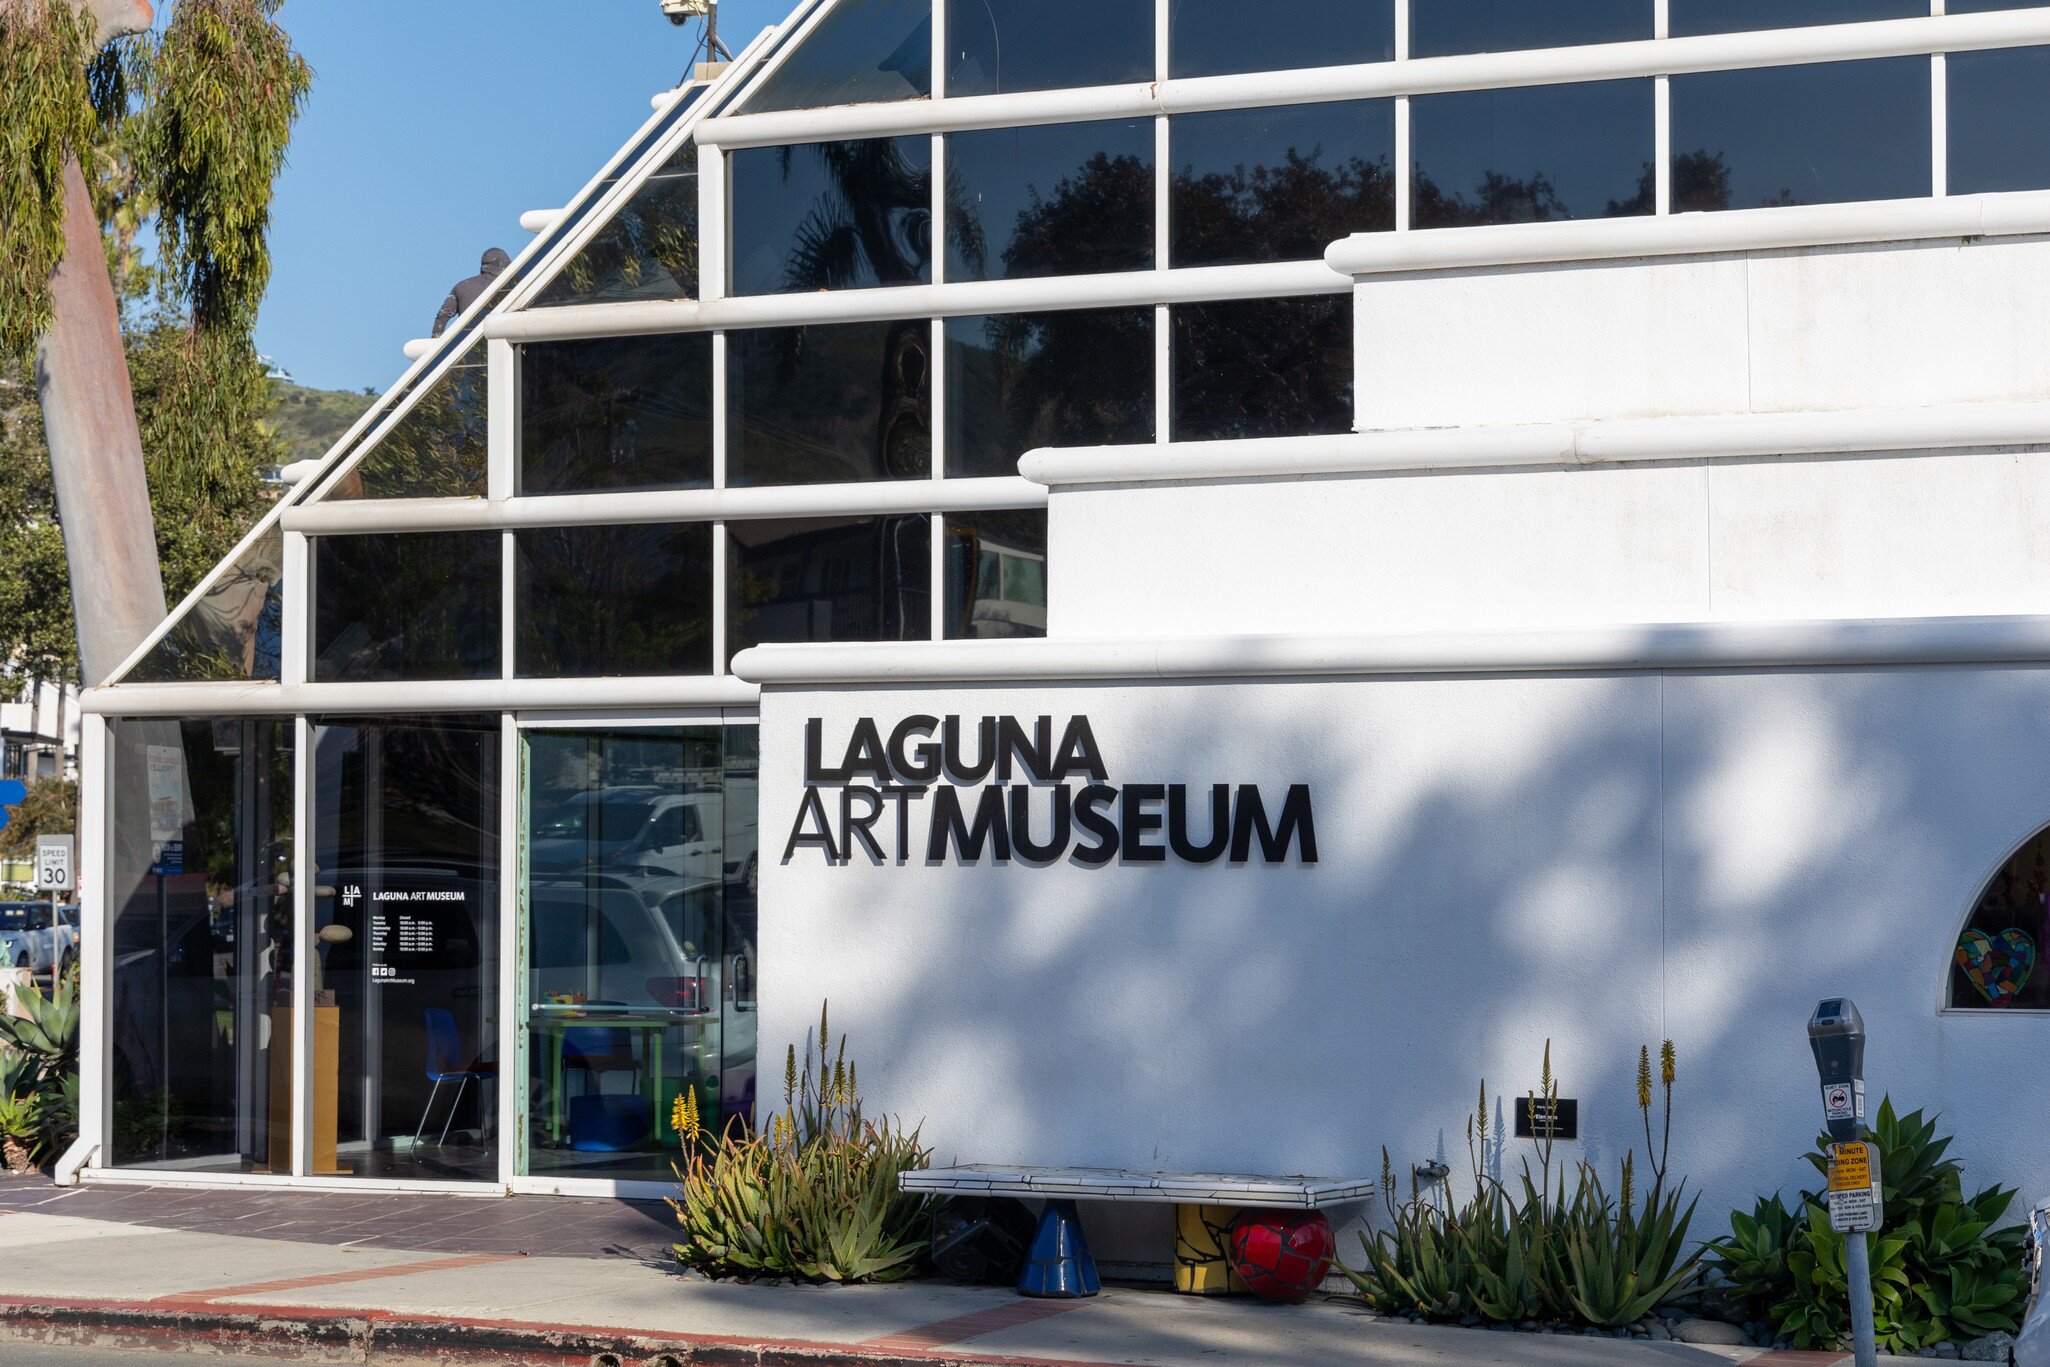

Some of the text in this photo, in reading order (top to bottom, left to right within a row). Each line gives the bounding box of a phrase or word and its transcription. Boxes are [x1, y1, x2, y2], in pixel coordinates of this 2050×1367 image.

[806, 714, 1109, 781] LAGUNA
[783, 783, 1319, 863] ART MUSEUM
[42, 849, 67, 857] SPEED
[44, 868, 65, 884] 30
[373, 891, 465, 900] LAGUNA ART MUSEUM
